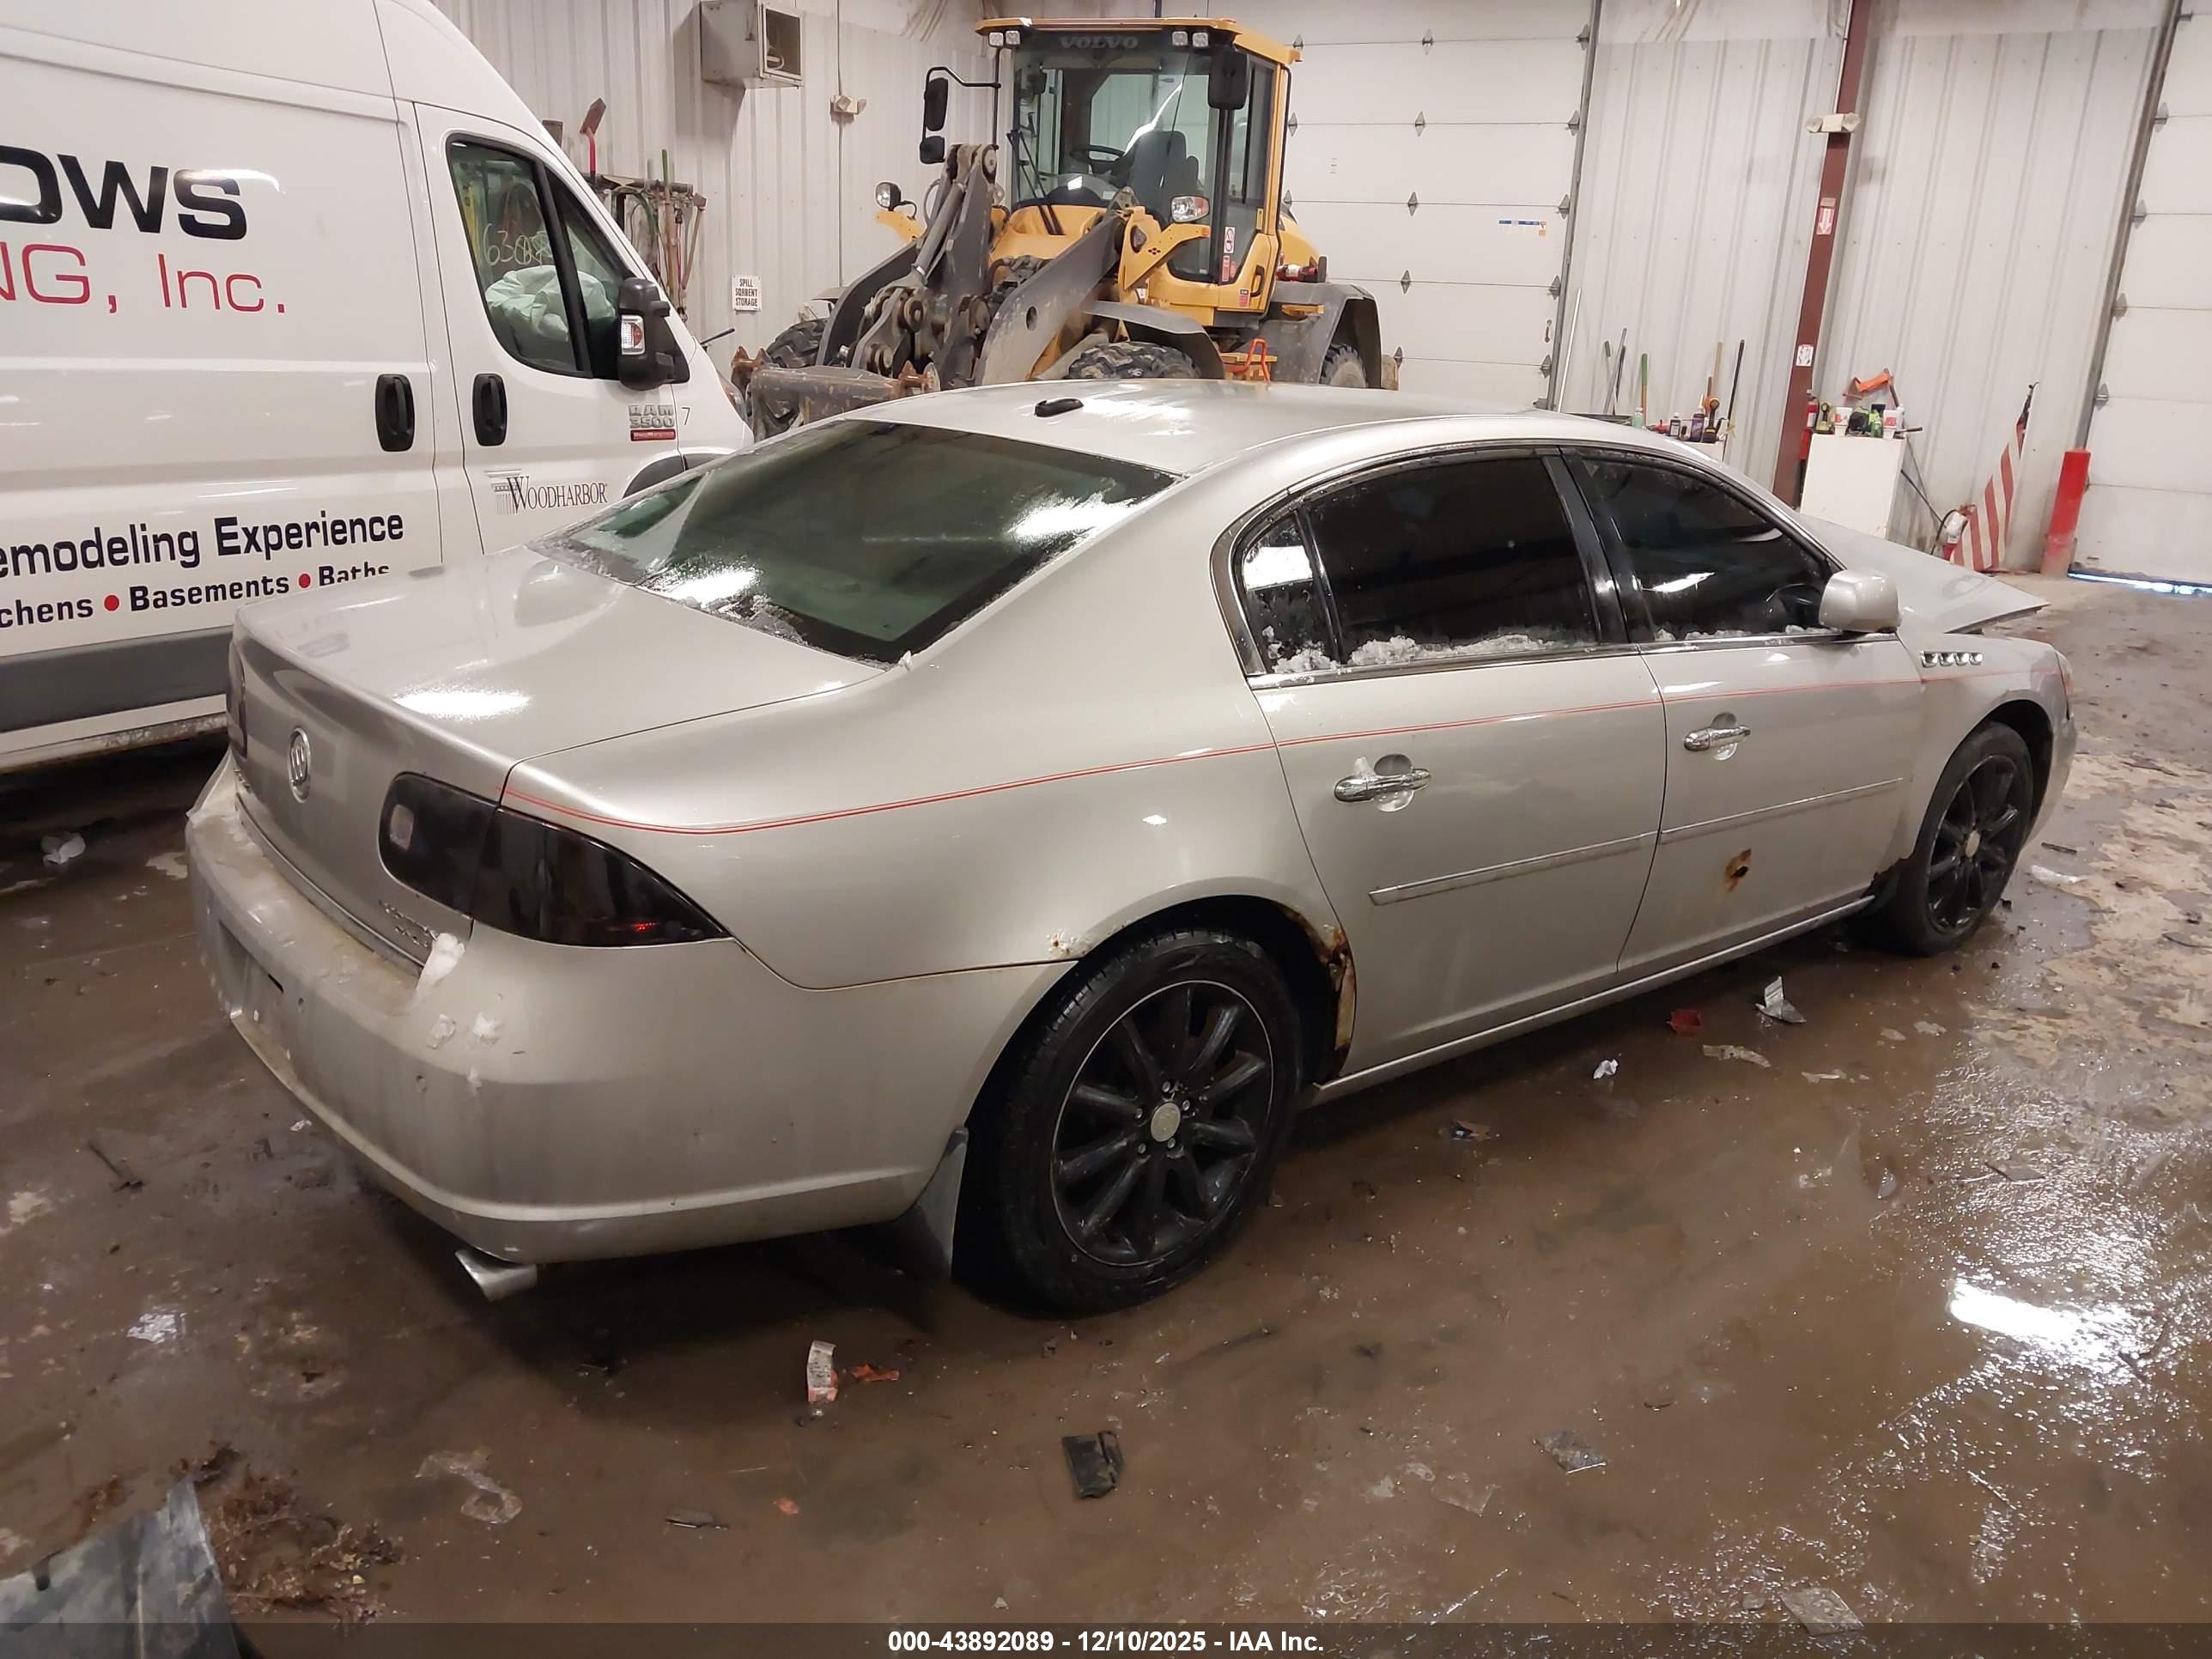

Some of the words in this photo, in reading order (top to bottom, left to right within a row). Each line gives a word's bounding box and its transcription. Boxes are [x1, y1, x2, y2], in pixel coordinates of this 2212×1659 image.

[1060, 36, 1139, 49] VOLVO
[0, 241, 117, 313] G,
[157, 253, 285, 313] Inc.
[739, 278, 753, 287] SPILL
[735, 288, 757, 297] SORBENT
[735, 297, 757, 307] STORAGE
[629, 416, 675, 428] 3500
[681, 407, 690, 425] 7
[507, 476, 609, 514] WOODHARBOR
[214, 510, 404, 561] Experience
[130, 574, 289, 611] Basements
